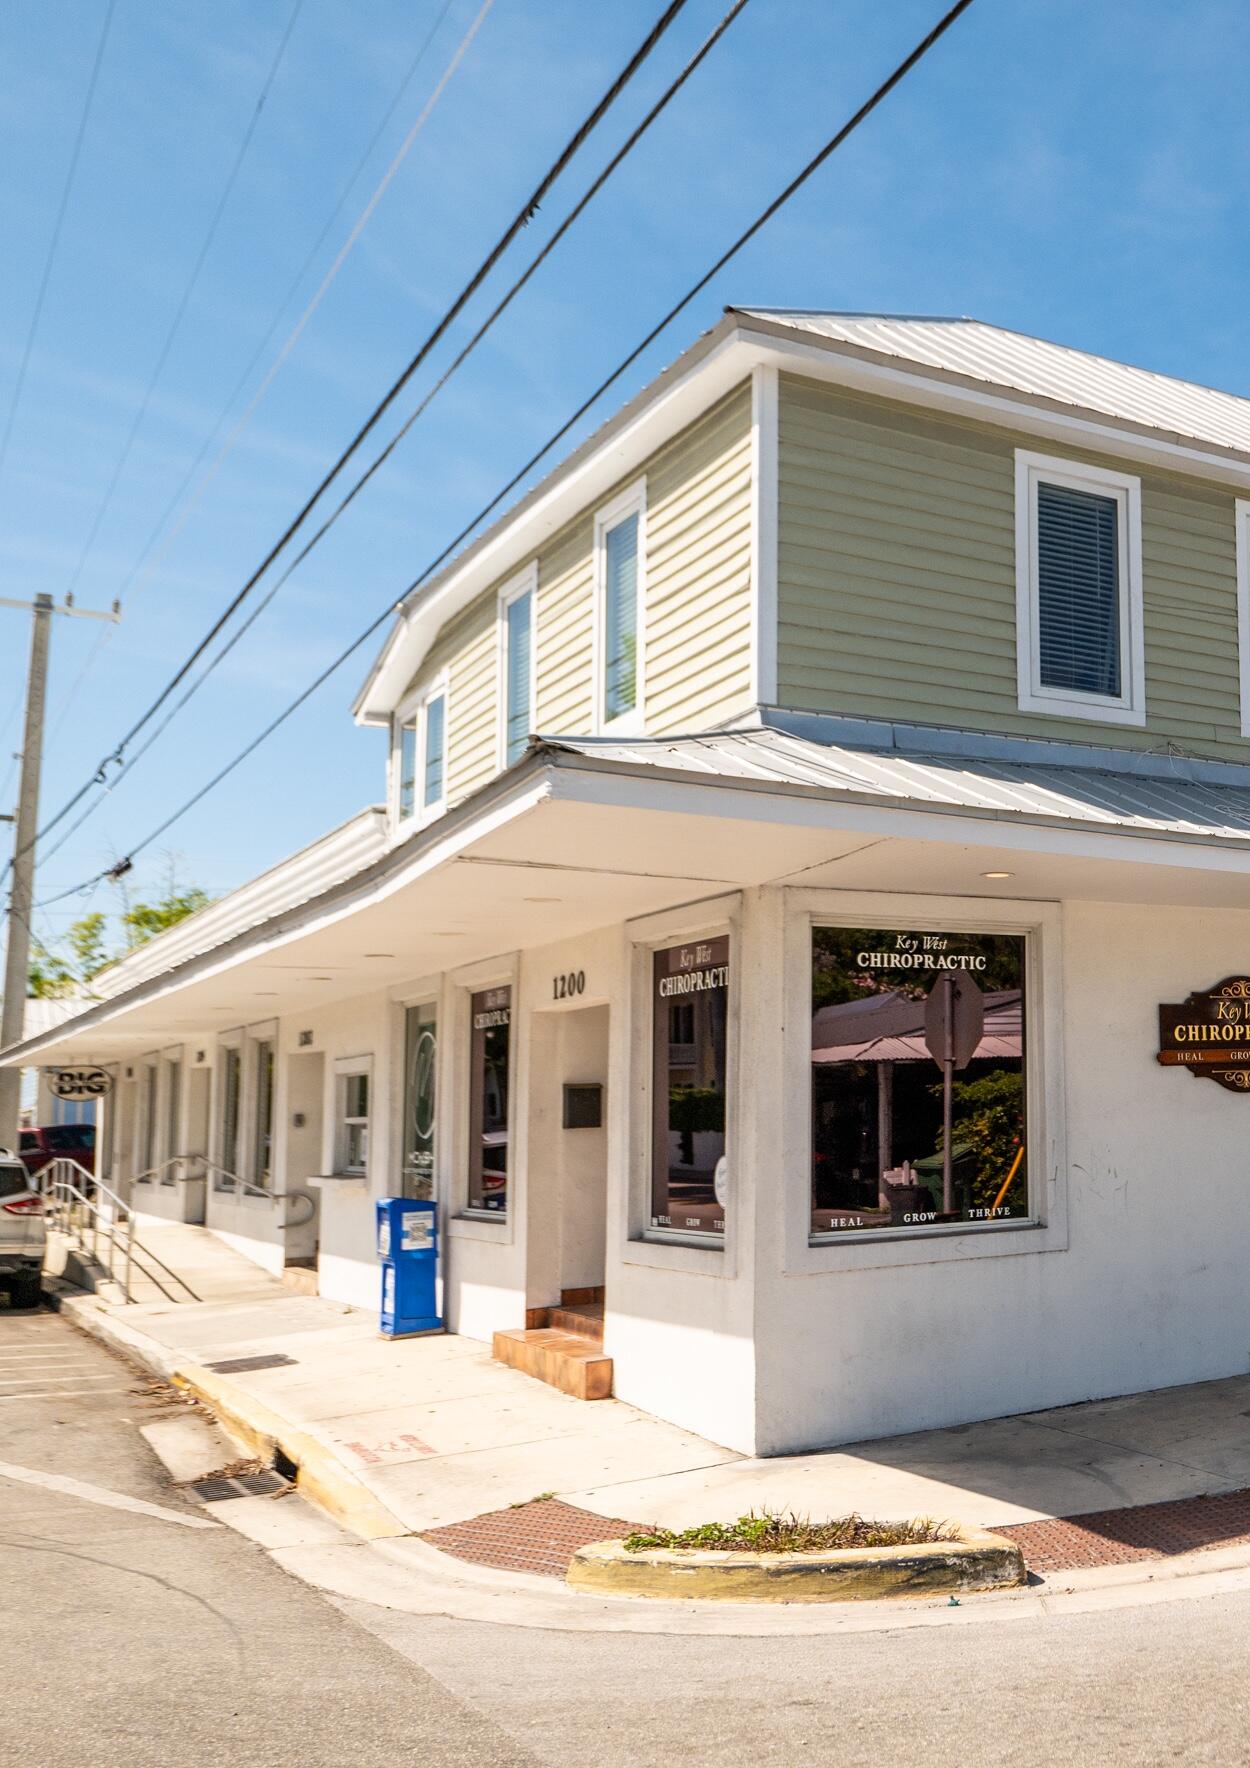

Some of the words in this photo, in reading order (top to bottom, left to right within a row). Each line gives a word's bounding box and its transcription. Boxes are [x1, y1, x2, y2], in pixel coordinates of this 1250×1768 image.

[896, 935, 918, 953] Key
[923, 936, 948, 950] West
[680, 948, 694, 971] Key
[696, 944, 712, 964] West
[857, 952, 986, 970] CHIROPRACTIC
[553, 970, 585, 1000] 1200
[660, 966, 729, 997] CHIROPRACTI
[1217, 1001, 1241, 1025] Key
[1177, 1052, 1204, 1061] HEAL
[831, 1217, 863, 1227] HEAL
[903, 1211, 937, 1222] GROW
[968, 1206, 1011, 1218] THRIVE
